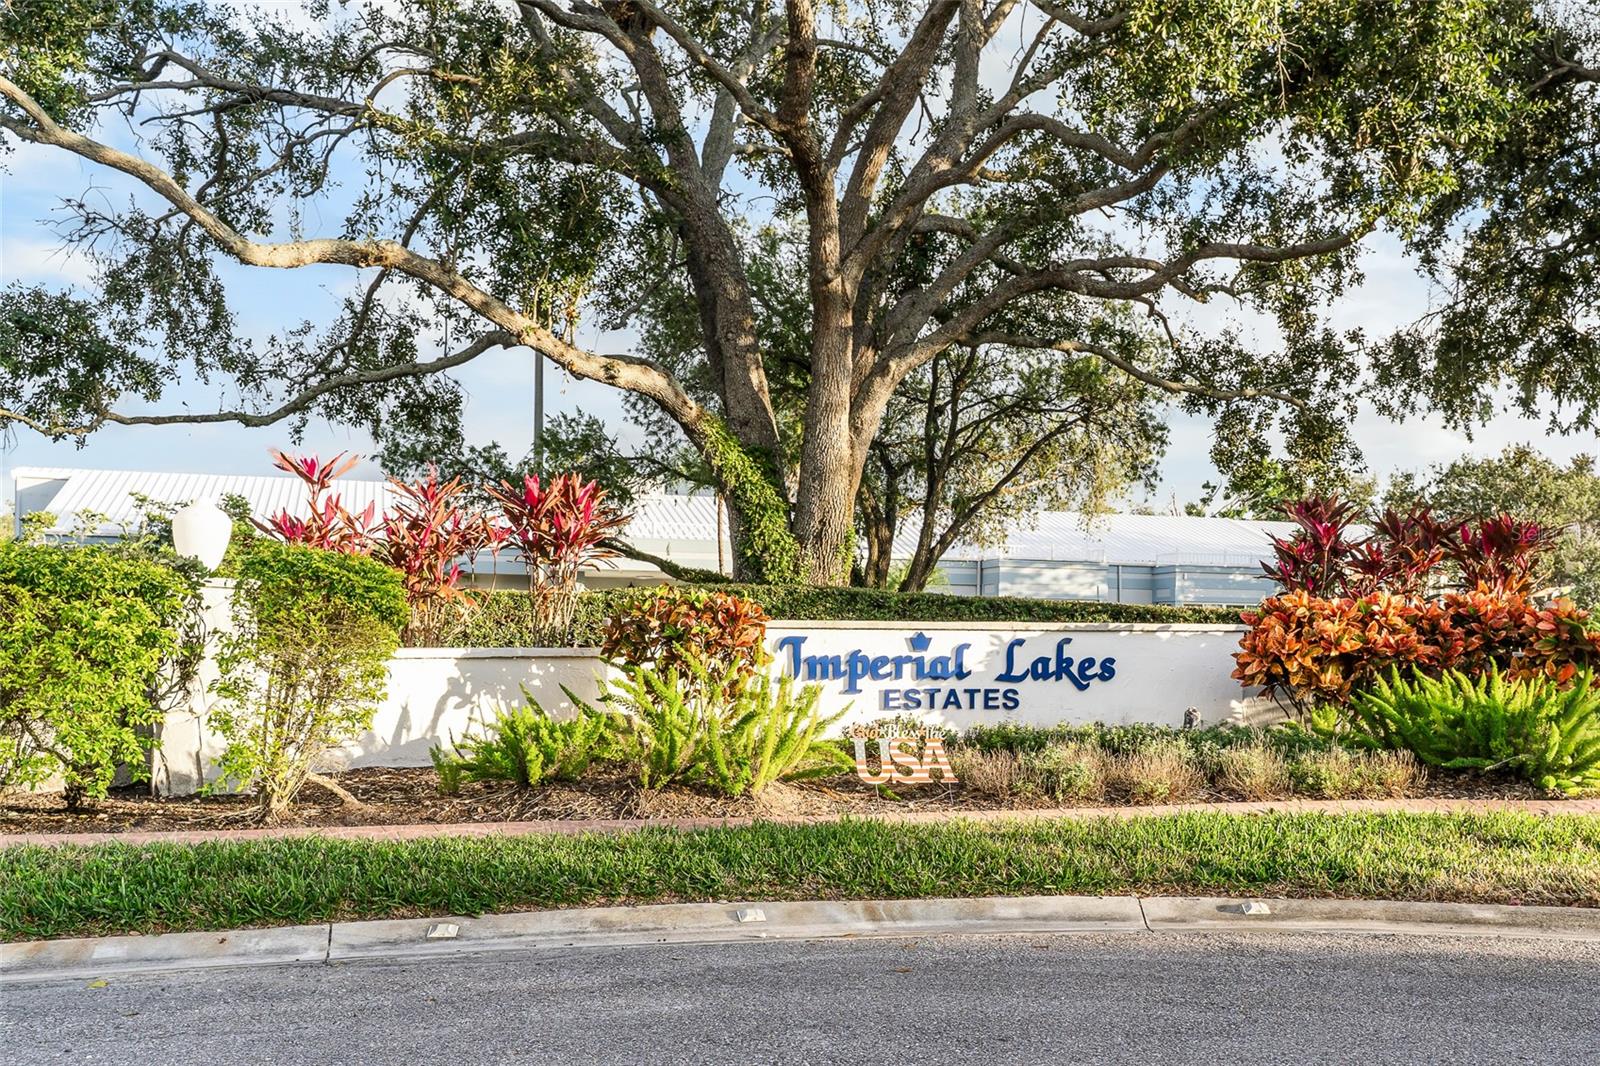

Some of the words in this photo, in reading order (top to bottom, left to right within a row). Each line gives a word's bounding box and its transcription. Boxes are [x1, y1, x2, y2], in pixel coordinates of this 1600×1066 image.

[775, 635, 972, 695] Imperial
[994, 637, 1116, 691] Lakes
[880, 688, 1020, 711] ESTATES
[850, 737, 959, 784] USA
